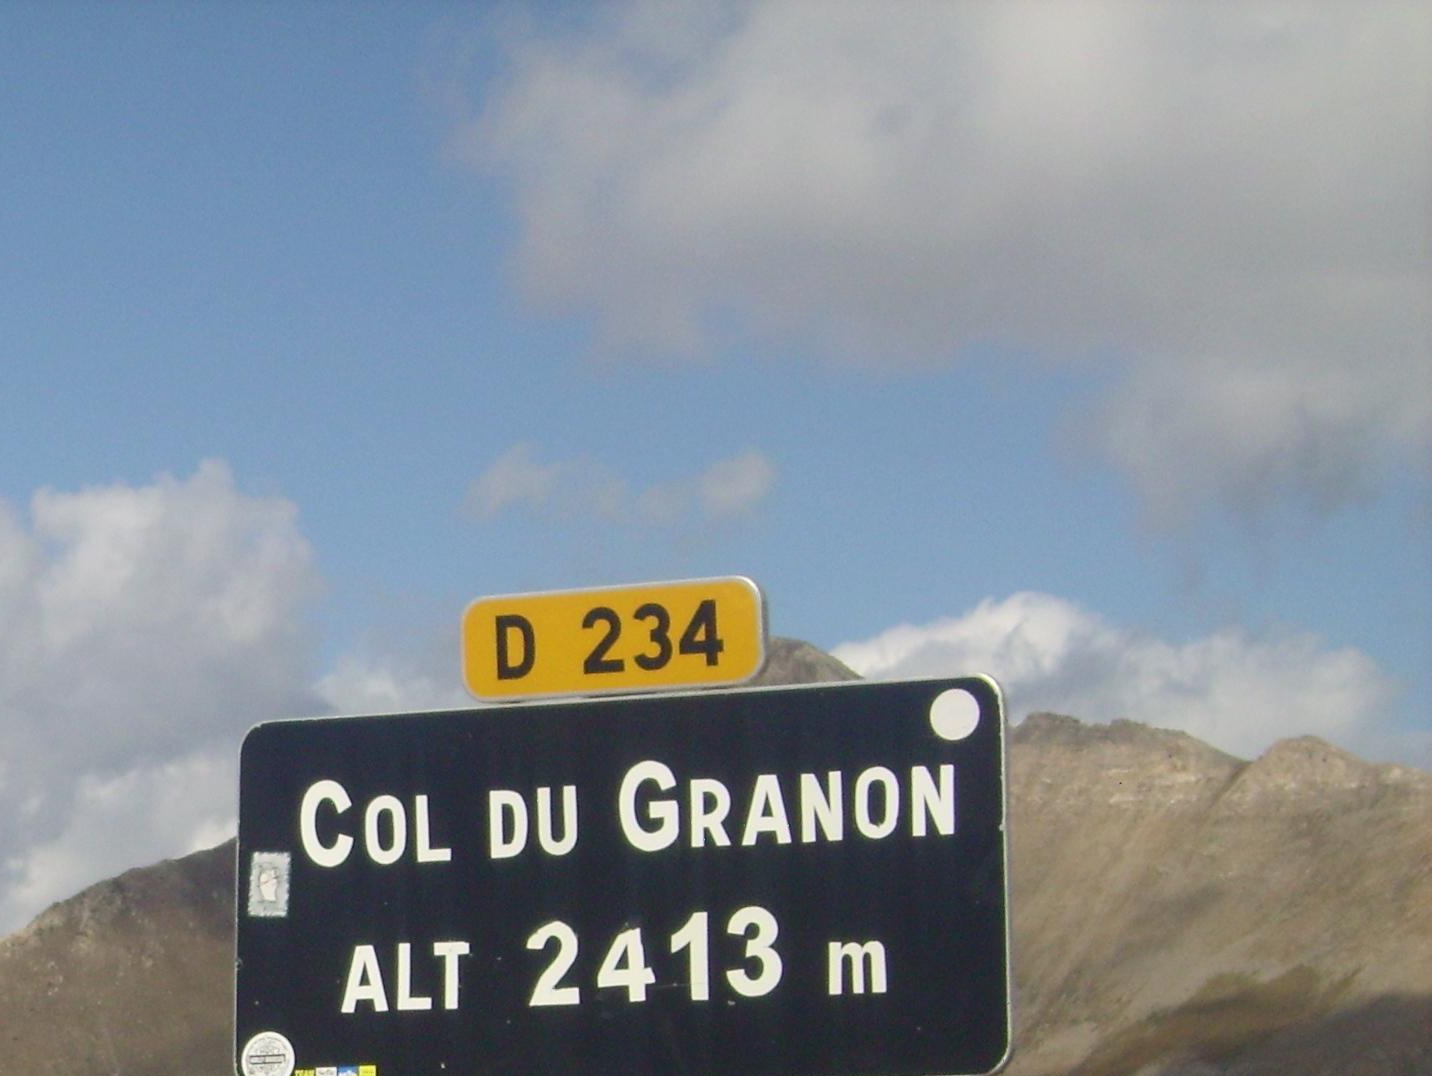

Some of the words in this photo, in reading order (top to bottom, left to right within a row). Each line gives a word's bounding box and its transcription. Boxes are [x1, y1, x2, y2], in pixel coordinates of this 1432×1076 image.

[495, 614, 536, 681] D
[581, 599, 724, 675] 234
[299, 779, 452, 868] COL
[489, 785, 578, 859] DU
[618, 760, 955, 852] GRANON
[340, 940, 470, 1014] ALT
[526, 905, 783, 1007] 2413
[828, 940, 887, 996] m
